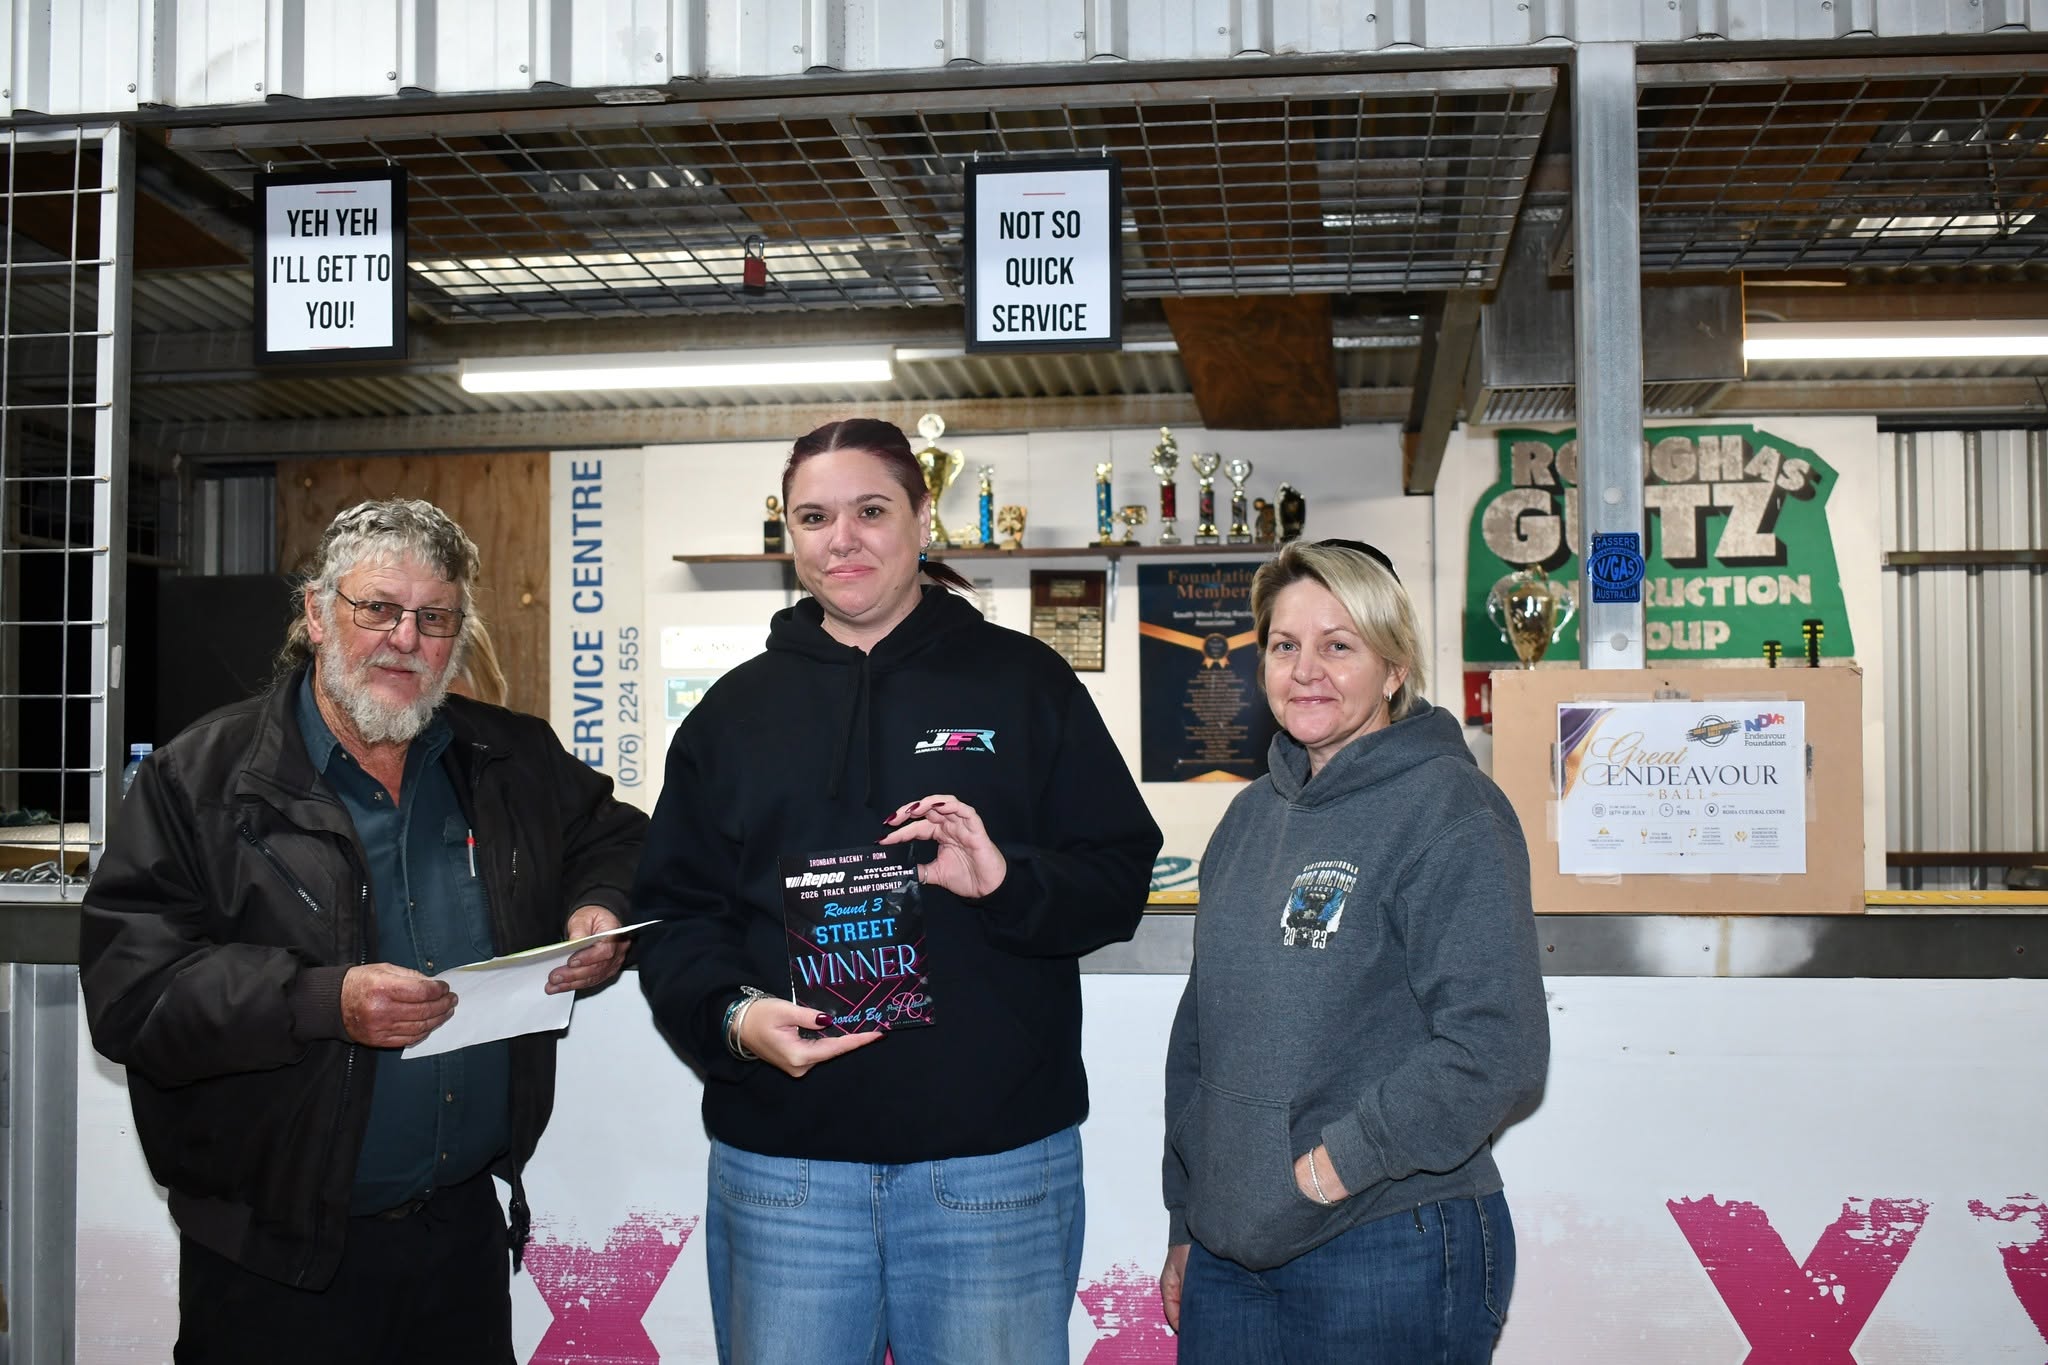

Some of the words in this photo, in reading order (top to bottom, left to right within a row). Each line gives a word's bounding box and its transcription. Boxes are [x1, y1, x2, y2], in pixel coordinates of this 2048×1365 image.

[287, 209, 329, 237] YEH
[336, 208, 377, 236] YEH
[1000, 211, 1044, 239] NOT
[1051, 210, 1080, 239] SO
[273, 255, 310, 283] I'LL
[317, 254, 357, 283] GET
[364, 254, 390, 282] TO
[1006, 257, 1074, 288] QUICK
[306, 301, 354, 329] YOU!
[992, 303, 1087, 332] SERVICE
[1511, 435, 1743, 486] RGH
[1745, 445, 1813, 492] AS
[1482, 482, 1776, 563] GTZ
[571, 460, 604, 614] CENTRE
[1595, 537, 1636, 550] GASSERS
[1168, 569, 1253, 585] Foundatio
[1596, 588, 1637, 600] AUSTRALIA
[619, 625, 639, 672] 555
[573, 630, 604, 767] ERVICE
[619, 680, 639, 724] 224
[915, 728, 996, 754] JFR
[1591, 731, 1689, 769] Great
[1744, 732, 1786, 740] Endeavour
[618, 733, 643, 788] (076)
[1583, 763, 1779, 787] ENDEAVOUR
[809, 857, 837, 868] IRONBARK
[872, 852, 887, 861] ROMA
[864, 865, 903, 874] TAYLOR'S
[800, 871, 846, 888] Repco
[853, 872, 880, 881] PARTS
[881, 869, 914, 879] CENTRE
[800, 891, 819, 900] 2026
[823, 888, 845, 897] TRACK
[849, 881, 903, 894] CHAMPIONSHIP
[824, 900, 868, 918] Round
[872, 897, 884, 912] 3
[815, 917, 896, 945] STREET
[1283, 927, 1296, 946] 20
[1312, 929, 1328, 949] 23
[796, 944, 919, 988] WINNER
[831, 1010, 862, 1025] sored
[866, 1007, 883, 1023] By
